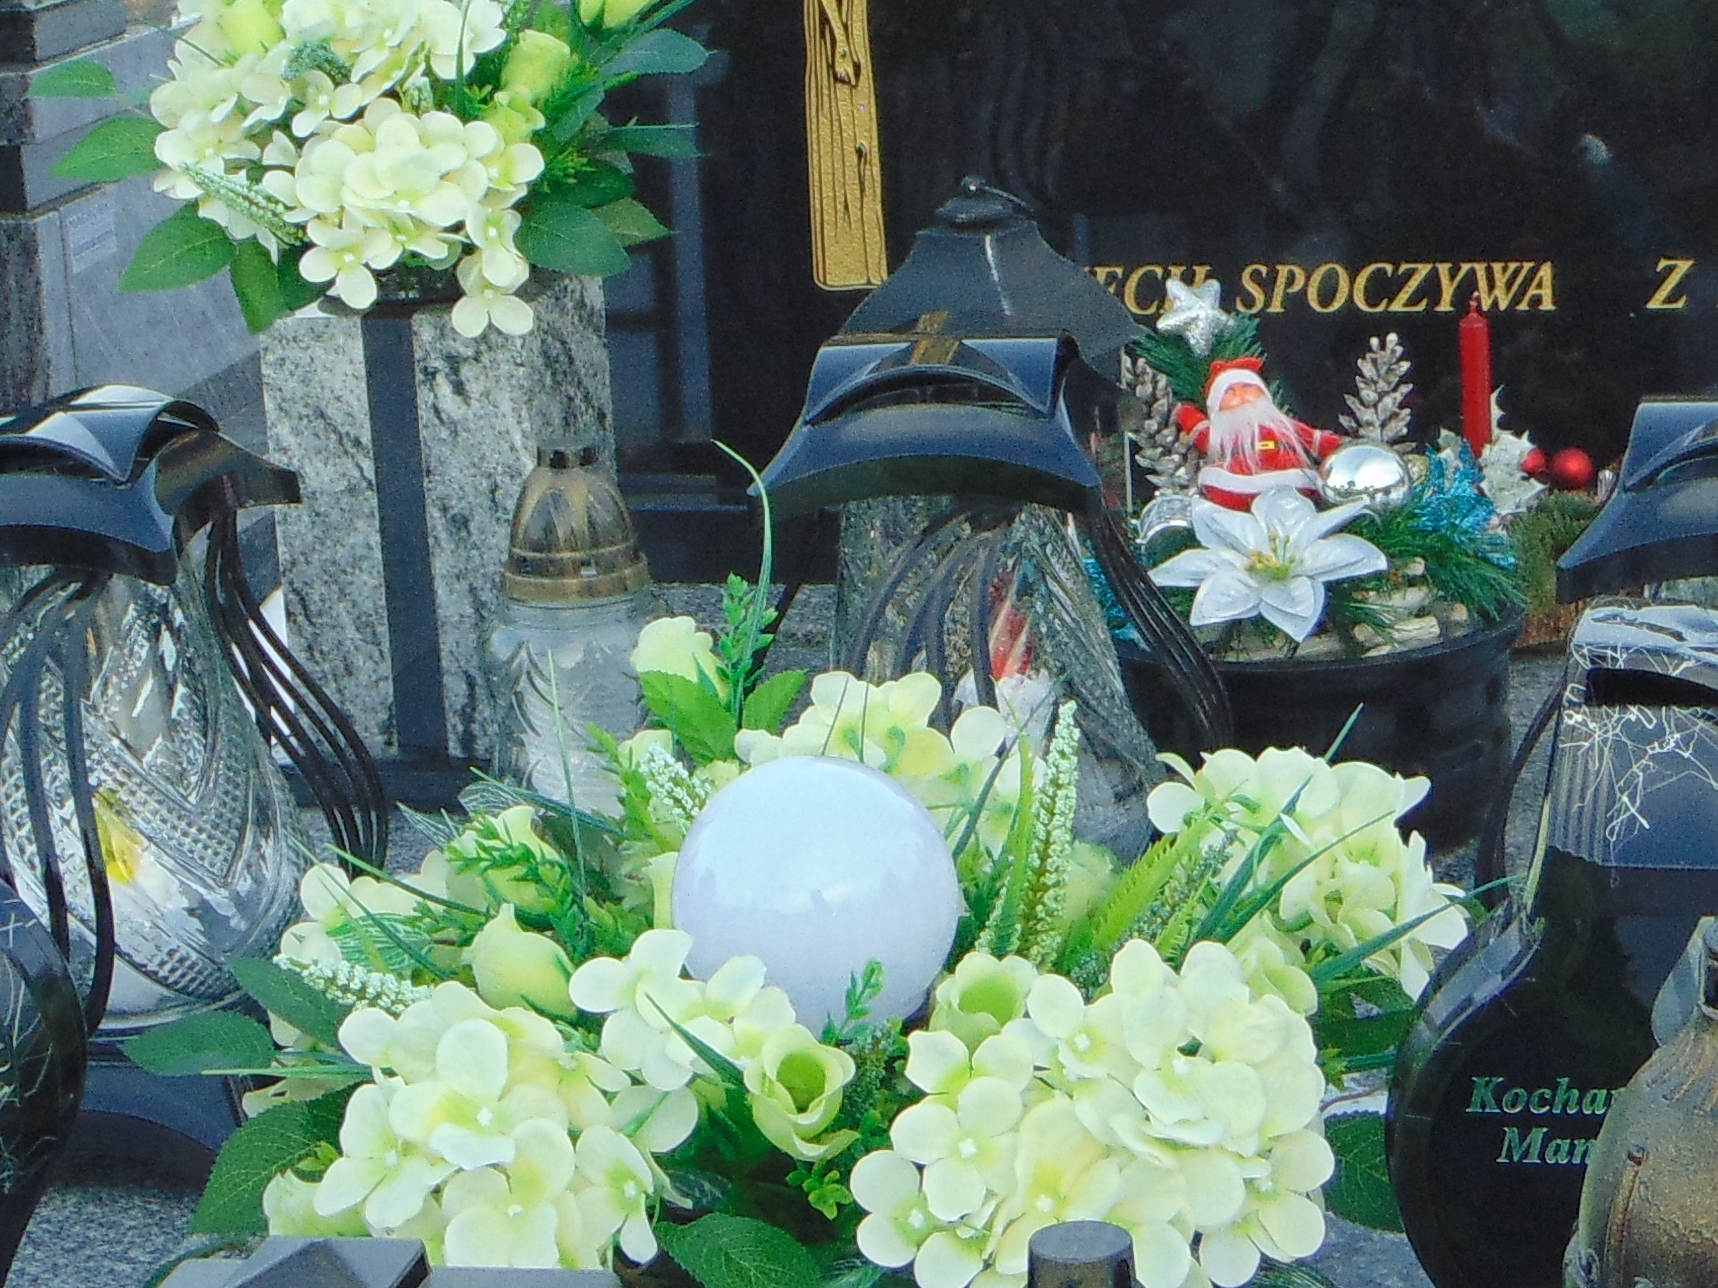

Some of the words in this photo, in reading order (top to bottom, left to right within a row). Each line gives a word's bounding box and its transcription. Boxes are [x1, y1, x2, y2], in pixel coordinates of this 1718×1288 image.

[1235, 260, 1558, 312] SPOCZYWA
[1646, 258, 1697, 309] Z
[1465, 1076, 1609, 1115] Kocha
